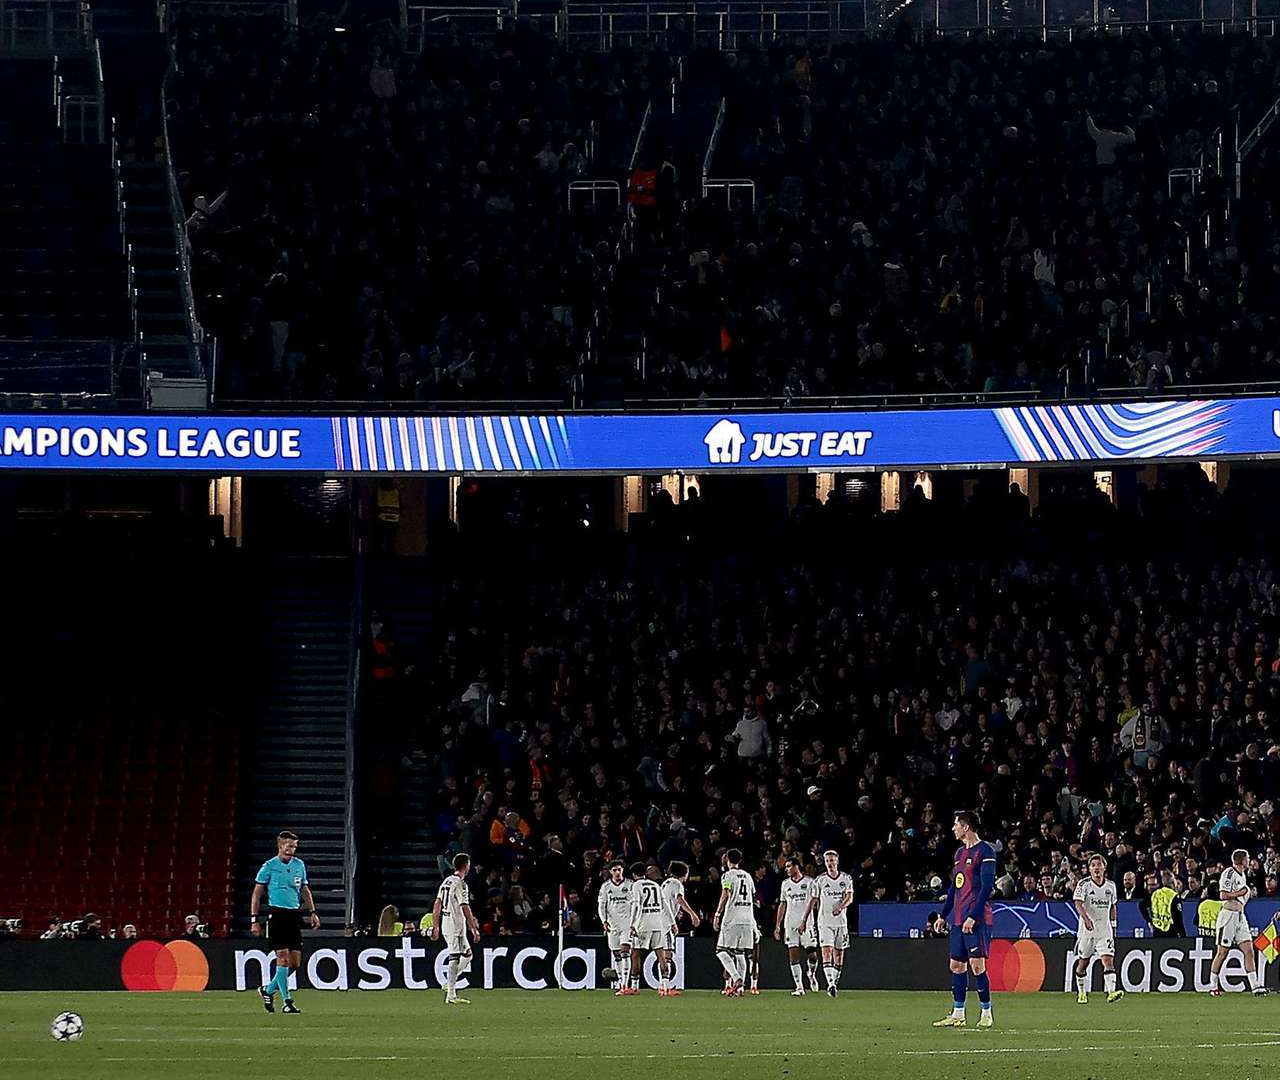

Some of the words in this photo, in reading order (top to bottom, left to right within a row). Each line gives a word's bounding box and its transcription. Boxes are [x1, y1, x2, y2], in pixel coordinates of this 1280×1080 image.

[158, 429, 301, 458] LEAGUE
[749, 434, 814, 462] JUST
[819, 431, 874, 457] EAT
[643, 887, 660, 907] 21
[739, 879, 748, 901] 4
[235, 936, 685, 990] mastercad
